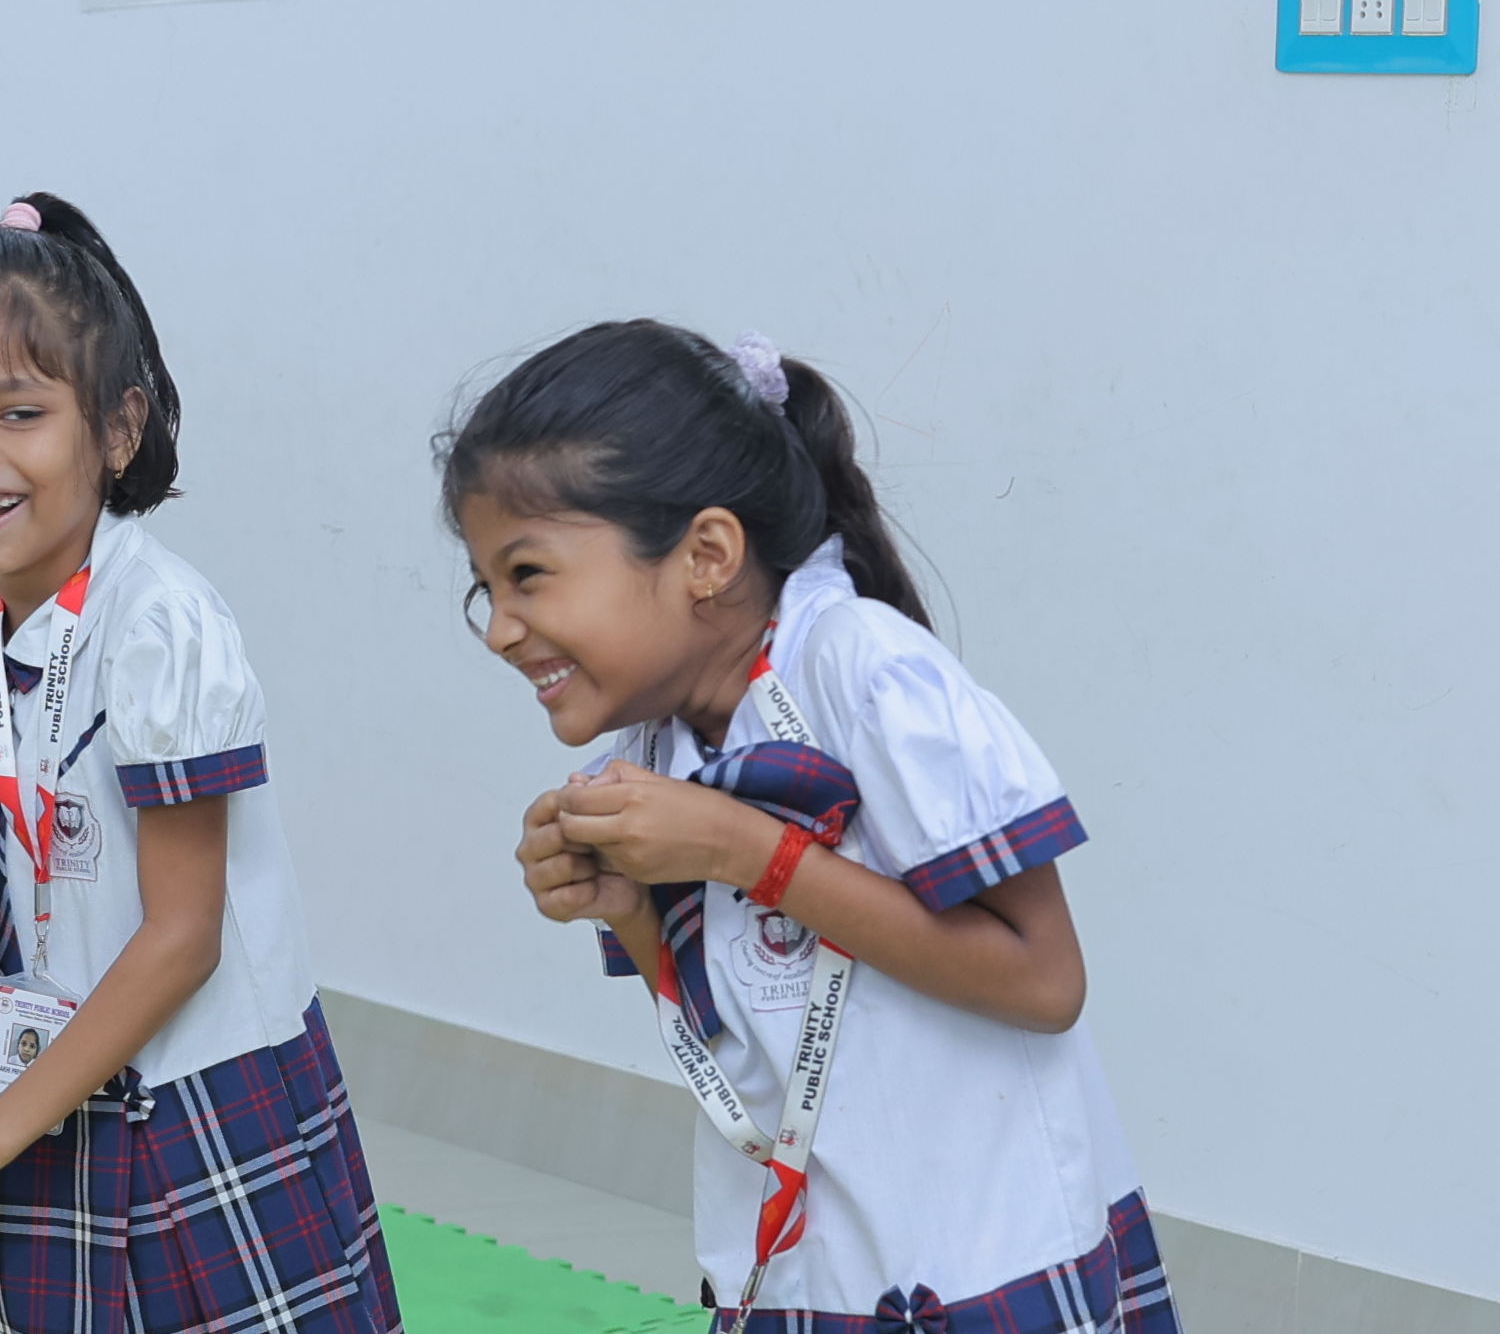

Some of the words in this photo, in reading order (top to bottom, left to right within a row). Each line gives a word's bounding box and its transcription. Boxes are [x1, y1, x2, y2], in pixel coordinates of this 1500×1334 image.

[44, 652, 59, 711] TRINITY
[57, 625, 75, 685] SCHOOL
[50, 689, 65, 743] PUBLIC
[767, 681, 810, 745] SCHOOL
[55, 858, 91, 869] TRINITY
[34, 1003, 51, 1014] PUBLIC
[51, 1008, 70, 1018] SCHOOL
[760, 980, 809, 996] TRINIT
[761, 993, 788, 1001] PUBLIC
[672, 1015, 709, 1063] SCHOOL
[795, 1001, 822, 1073] TRINITY
[801, 1048, 827, 1110] PUBLIC
[818, 969, 844, 1042] SCHOOL
[672, 1043, 712, 1101] TRINITY
[704, 1065, 743, 1122] PUBLIC
